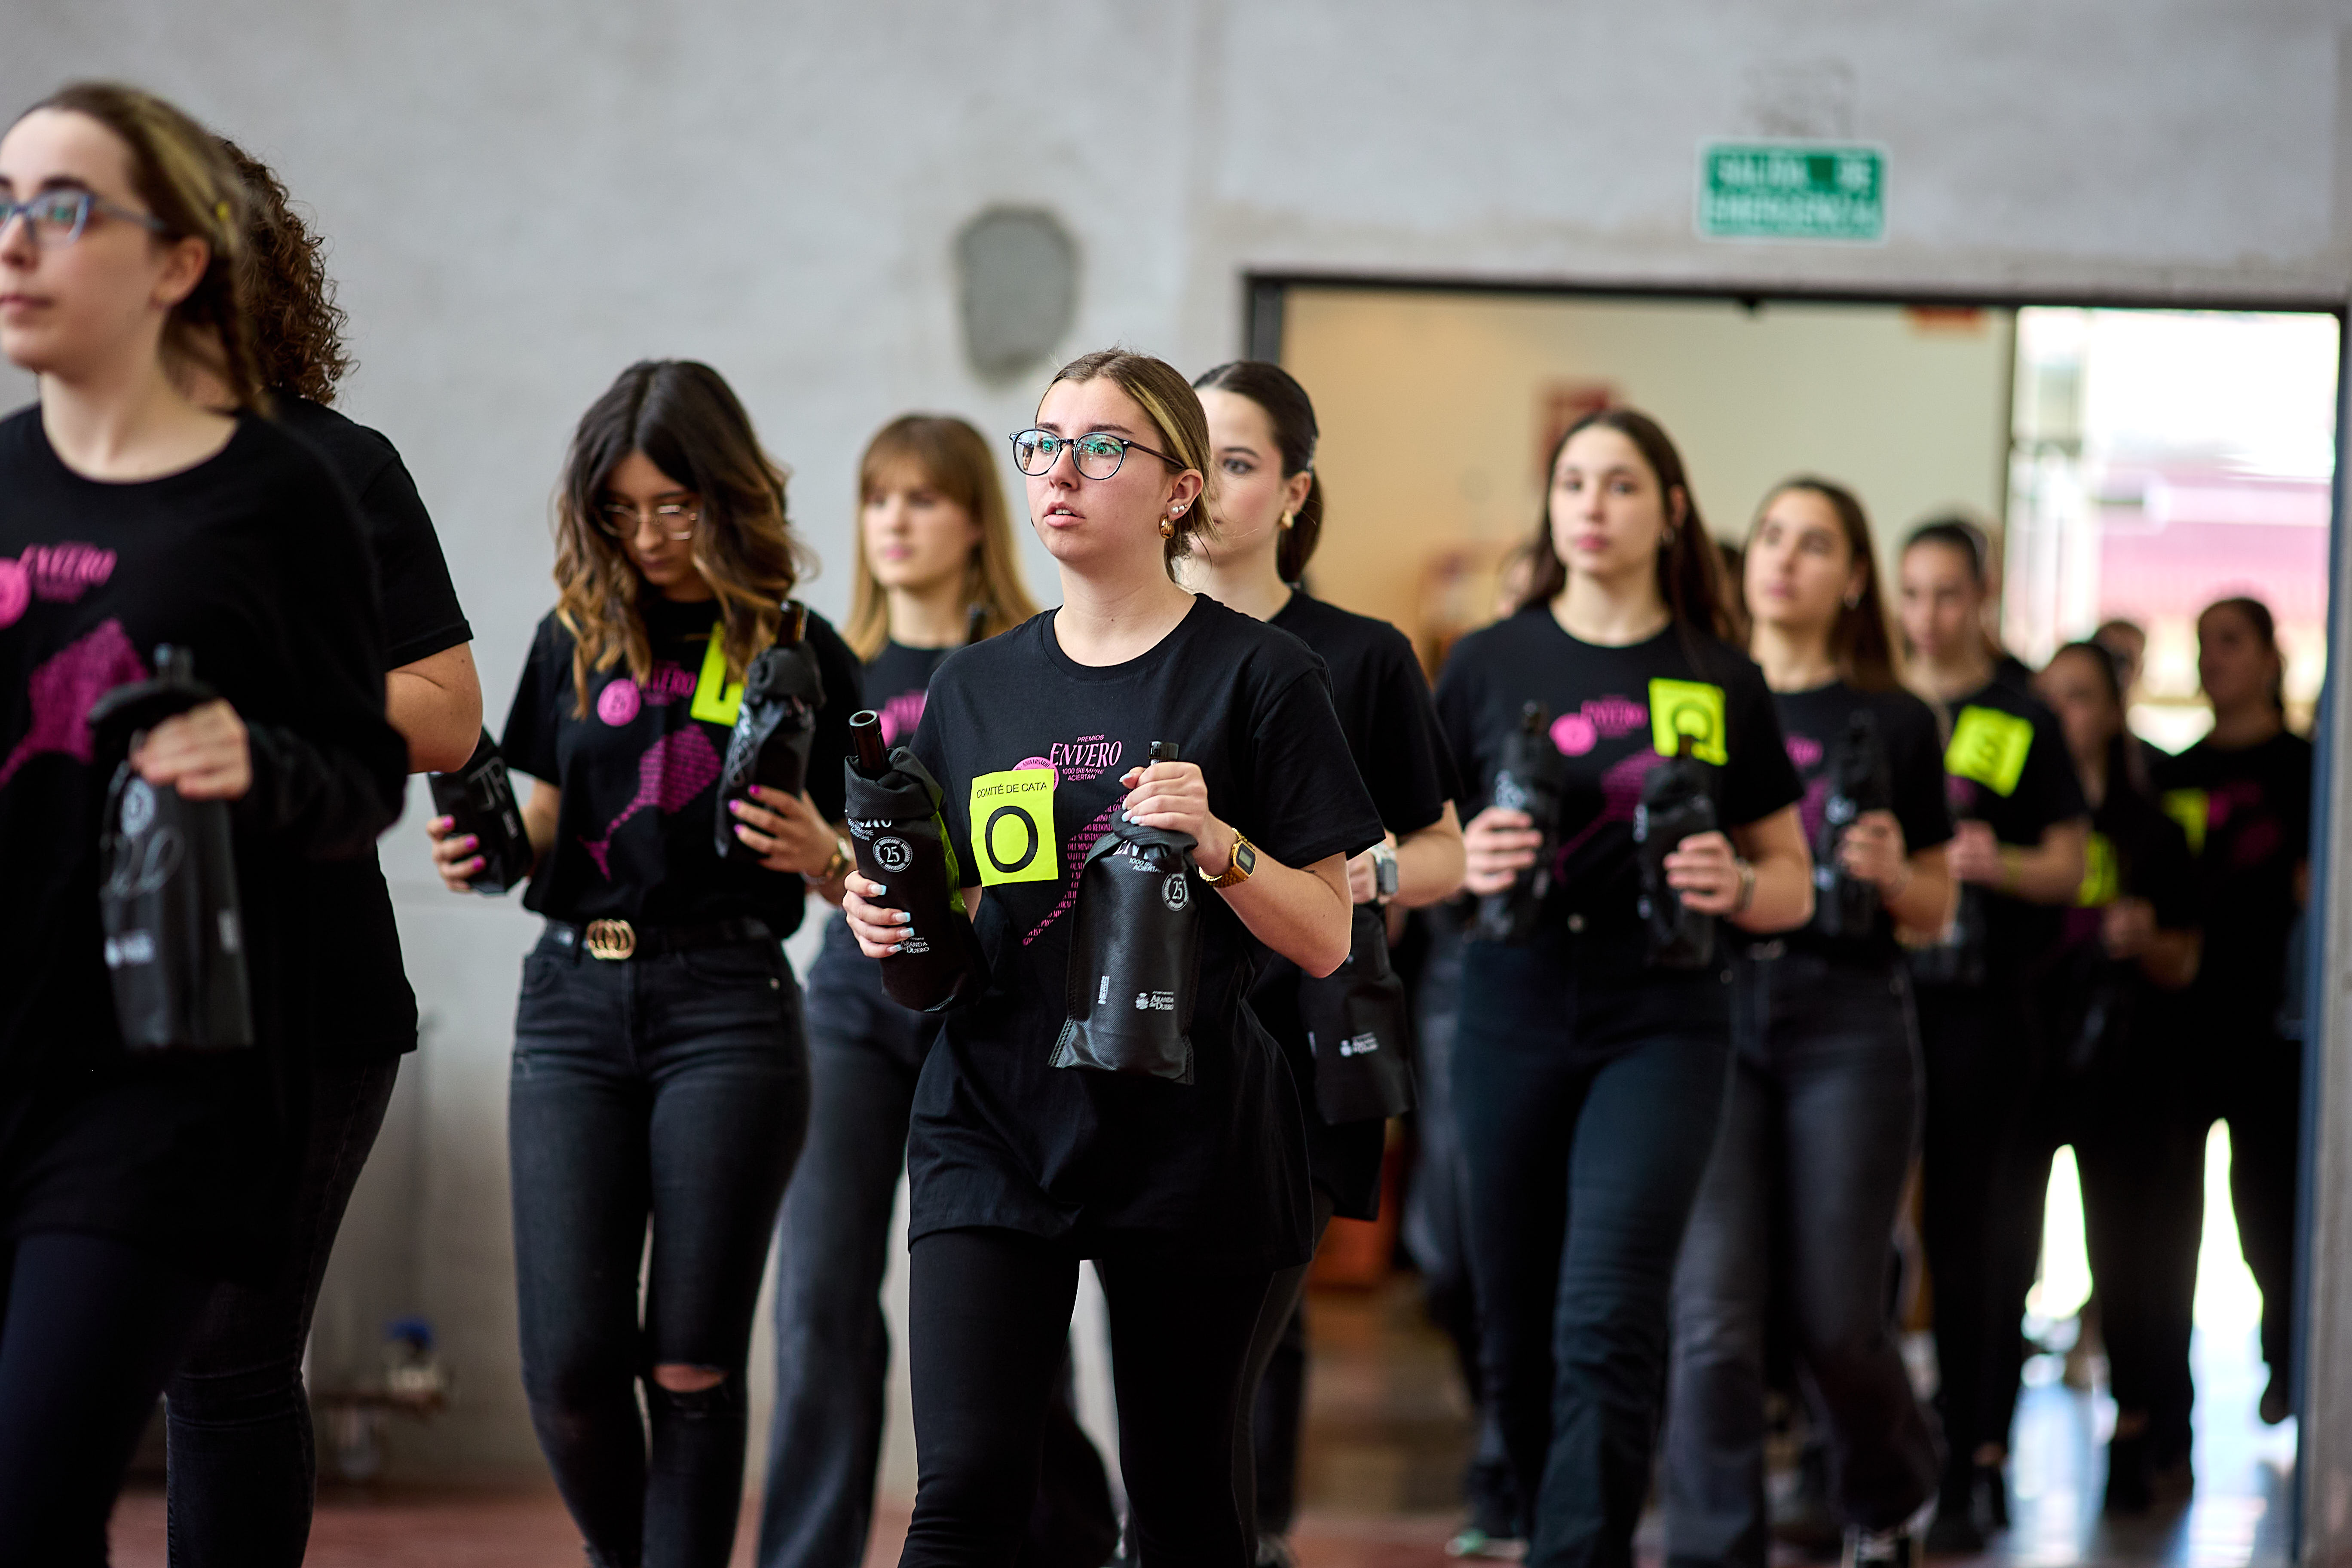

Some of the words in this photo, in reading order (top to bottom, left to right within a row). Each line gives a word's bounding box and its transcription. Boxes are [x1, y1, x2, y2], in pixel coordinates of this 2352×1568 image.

[1077, 734, 1104, 743] PREMIOS
[1050, 741, 1122, 768] ENVERO
[1076, 767, 1105, 775] SIEMPRE
[977, 783, 1004, 799] COMITÉ
[1006, 784, 1019, 794] DE
[1021, 781, 1047, 792] CATA
[985, 805, 1039, 873] O
[883, 846, 900, 863] 25
[1172, 880, 1183, 900] 25
